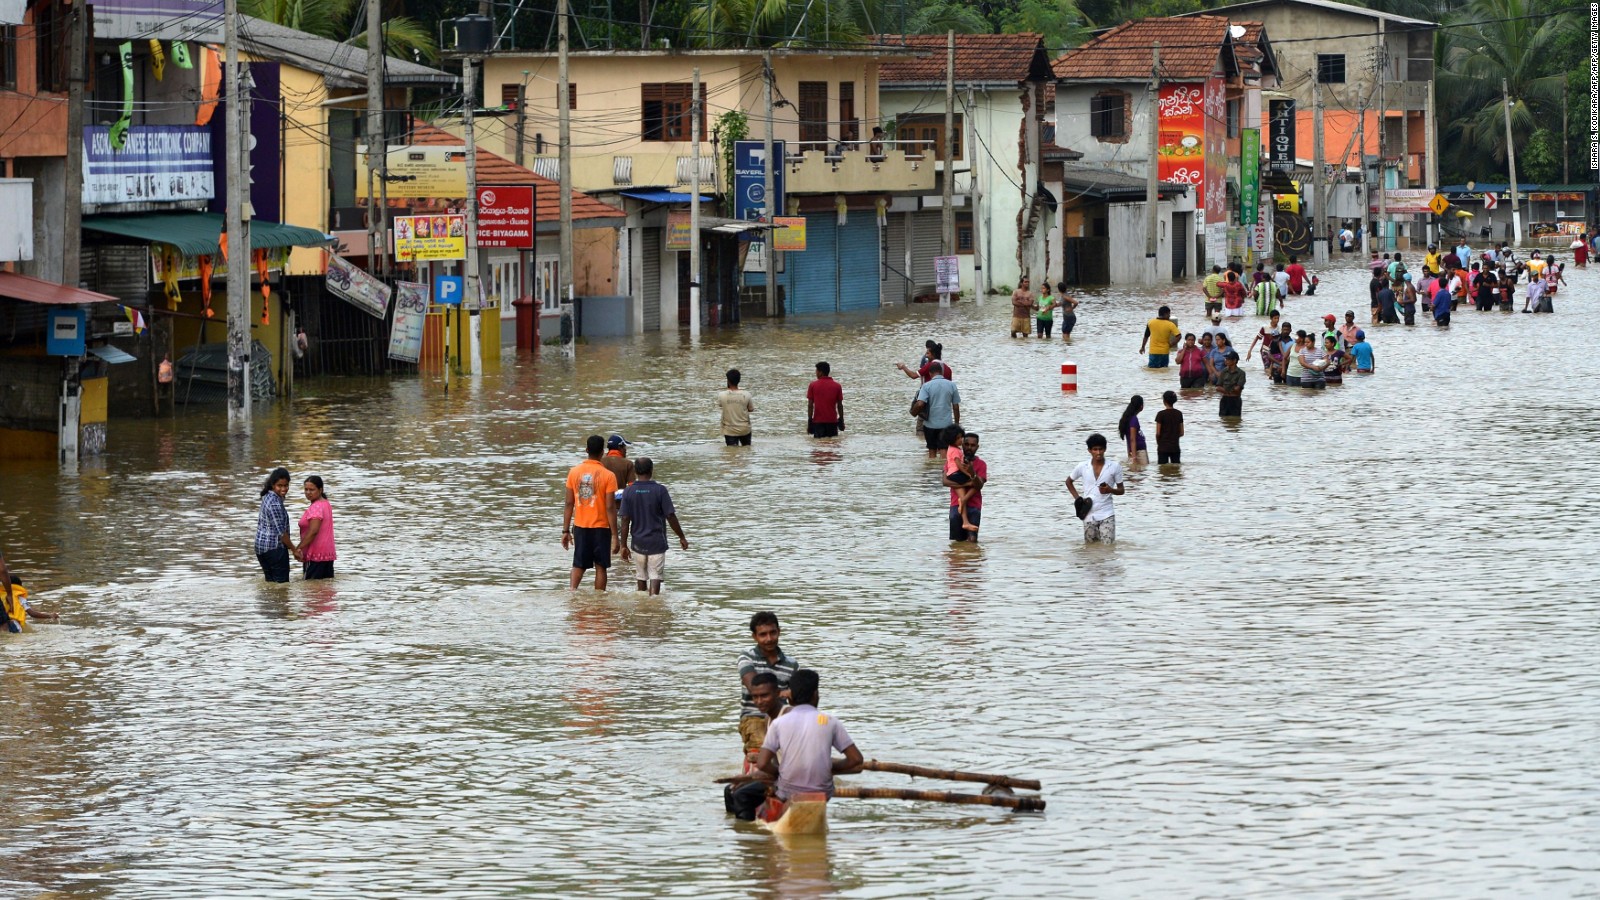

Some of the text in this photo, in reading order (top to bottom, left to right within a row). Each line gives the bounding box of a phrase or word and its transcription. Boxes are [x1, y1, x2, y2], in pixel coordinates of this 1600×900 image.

[1275, 101, 1290, 160] ANTIQUE
[115, 133, 146, 155] ANESE
[147, 132, 182, 154] ELECTRONIC
[183, 132, 211, 153] COMPANY
[441, 281, 457, 299] P
